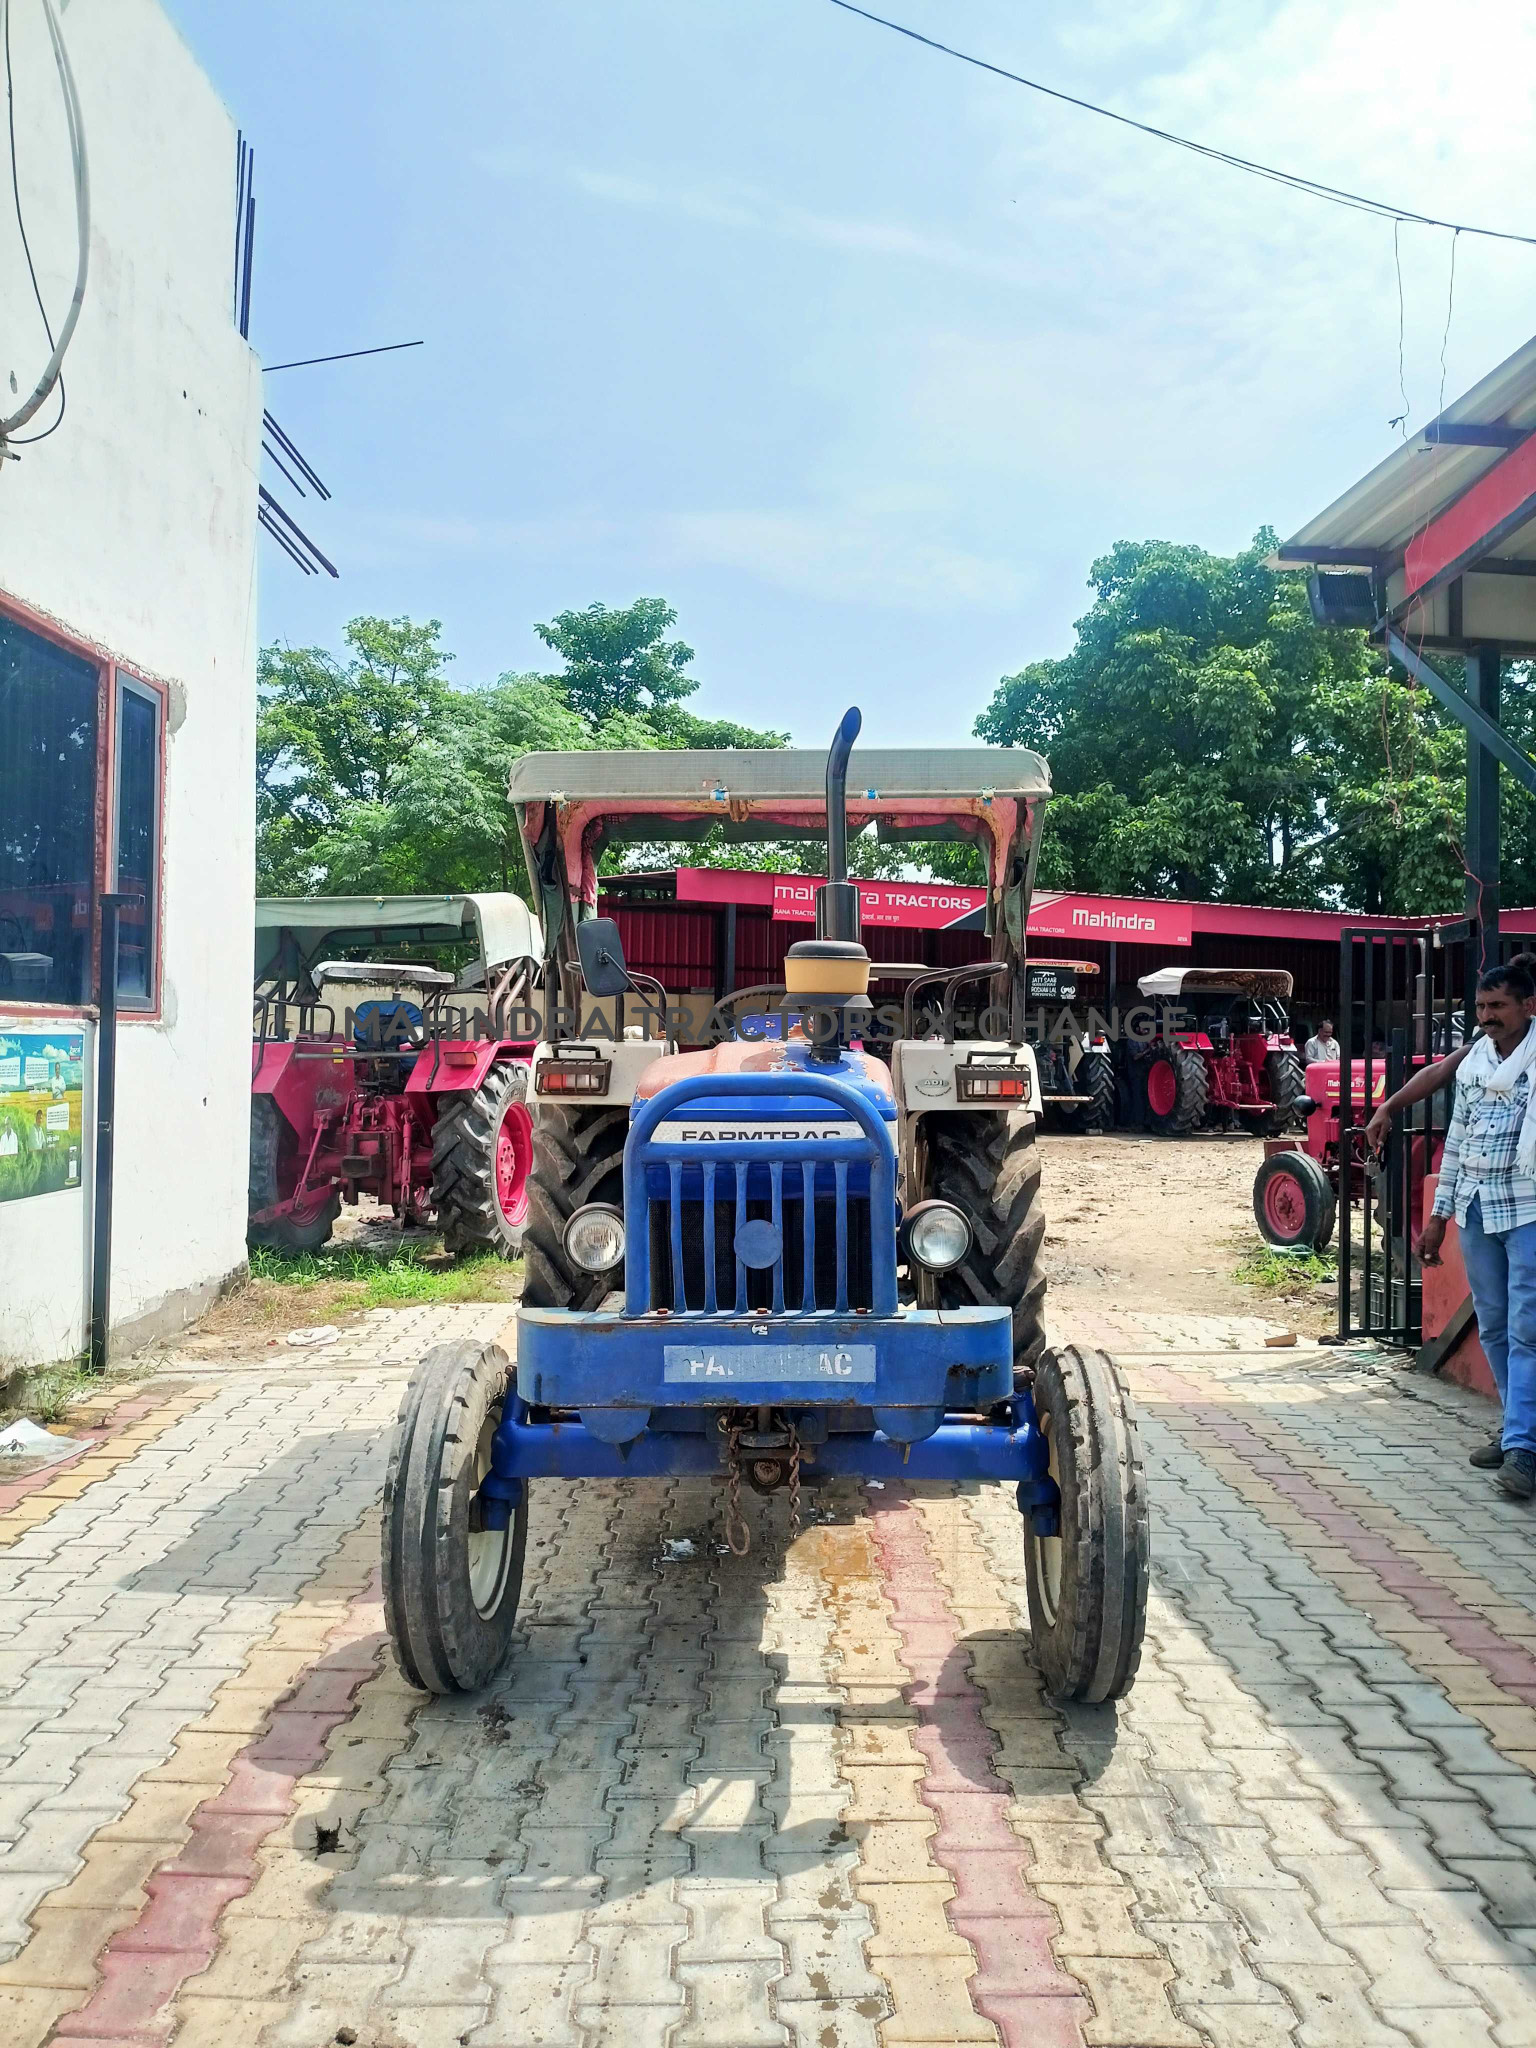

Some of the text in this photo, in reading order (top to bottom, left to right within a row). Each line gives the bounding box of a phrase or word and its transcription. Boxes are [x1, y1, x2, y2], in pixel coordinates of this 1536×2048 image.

[885, 893, 972, 910] TRACTORS
[1072, 908, 1156, 931] Mahindra
[1039, 926, 1065, 934] TRACTORS
